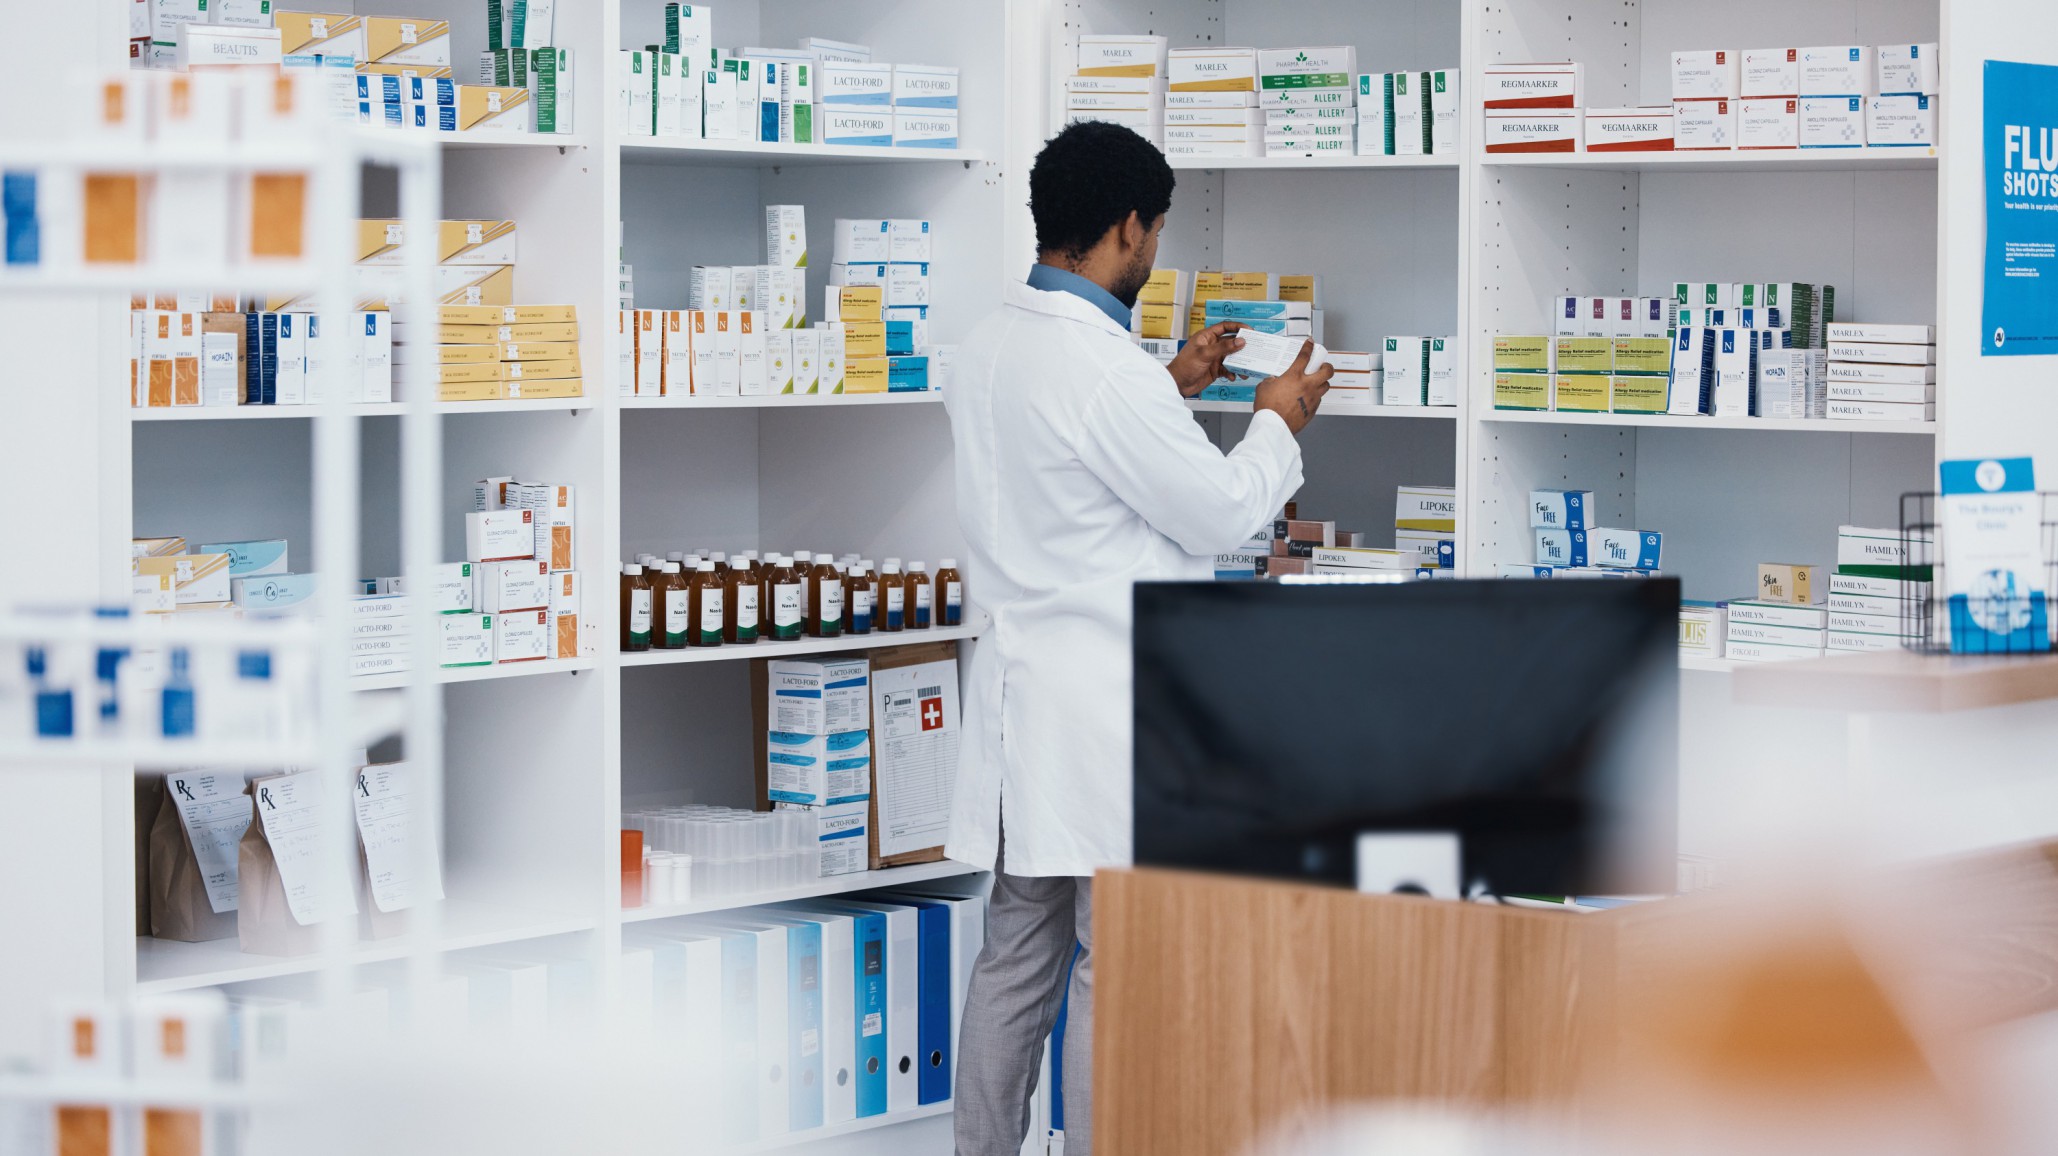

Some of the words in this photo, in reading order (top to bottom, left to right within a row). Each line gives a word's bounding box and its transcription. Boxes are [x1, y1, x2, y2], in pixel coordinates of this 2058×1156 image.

[684, 7, 690, 15] N
[214, 44, 258, 56] BEAUTIS
[634, 63, 641, 71] N
[663, 65, 669, 74] N
[682, 67, 687, 75] N
[709, 72, 715, 81] N
[742, 70, 747, 78] N
[834, 77, 882, 87] LACTO-FORD
[905, 80, 950, 90] LACTO-FORD
[1436, 82, 1444, 90] N
[1501, 80, 1558, 88] REGMAARKER
[359, 86, 367, 95] N
[414, 88, 421, 97] N
[1361, 84, 1368, 93] N
[1398, 84, 1405, 92] N
[1314, 94, 1341, 103] ALLERY
[1318, 109, 1345, 117] ALLERY
[417, 115, 424, 124] N
[834, 119, 884, 129] LACTO-FORD
[905, 122, 950, 132] LACTO-FORD
[1315, 126, 1341, 135] ALLERY
[1502, 124, 1559, 132] REGMAARKER
[1317, 141, 1342, 149] ALLERY
[2004, 124, 2058, 171] FLU
[2004, 171, 2058, 198] SHOTS
[1678, 293, 1686, 302] N
[1708, 293, 1715, 302] N
[1768, 295, 1775, 303] N
[671, 321, 678, 329] N
[697, 322, 703, 330] N
[743, 323, 750, 331] N
[1744, 320, 1751, 328] N
[282, 327, 290, 335] N
[311, 327, 317, 335] N
[367, 325, 374, 333] N
[1388, 341, 1395, 349] N
[1435, 340, 1442, 348] N
[1681, 340, 1688, 348] N
[1725, 342, 1732, 351] N
[1832, 348, 1864, 356] MARLEX
[1831, 368, 1863, 377] MARLEX
[1831, 388, 1863, 396] MARLEX
[1831, 406, 1862, 414] MARLEX
[1420, 501, 1455, 512] LIPOKE
[1536, 502, 1549, 513] Face
[1543, 512, 1556, 523] FREE
[1542, 537, 1554, 548] Face
[1604, 539, 1619, 550] Face
[1549, 547, 1561, 558] FREE
[1612, 549, 1627, 560] FREE
[1865, 545, 1906, 556] HAMILYN
[1318, 554, 1346, 562] LIPOKEX
[1763, 574, 1777, 586] Skin
[1833, 581, 1867, 589] HAMILYN
[1770, 585, 1783, 596] FREE
[353, 604, 392, 613] LACTO-FORD
[1830, 600, 1864, 608] HAMILYN
[1731, 610, 1764, 619] HAMILYN
[1831, 618, 1865, 627] HAMILYN
[353, 624, 392, 634] LACTO-FORD
[1679, 623, 1706, 643] LUS
[1731, 628, 1764, 638] HAMILYN
[352, 642, 391, 651] LACTO-FORD
[1831, 638, 1865, 647] HAMILYN
[355, 659, 393, 669] LACTO-FORD
[830, 668, 862, 677] LACTO-FORD
[783, 677, 819, 686] LACTO-FORD
[884, 695, 891, 712] P
[825, 818, 859, 829] LACTO-FORD
